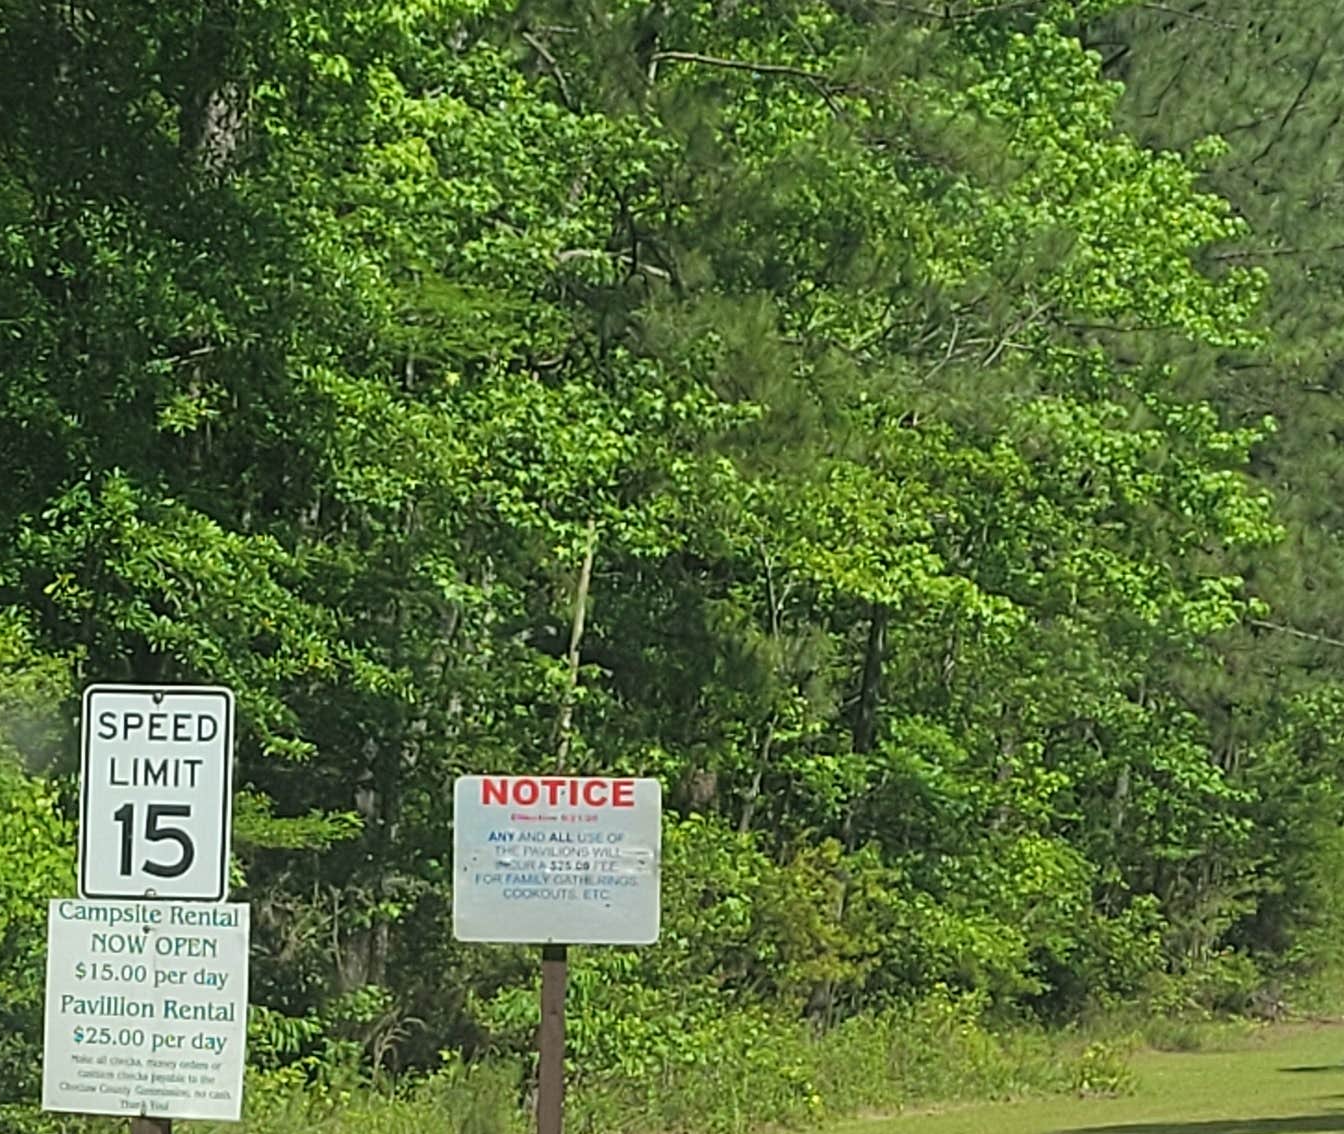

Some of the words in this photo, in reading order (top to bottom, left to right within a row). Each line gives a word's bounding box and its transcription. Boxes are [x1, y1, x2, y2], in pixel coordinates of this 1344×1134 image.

[97, 711, 218, 743] SPEED
[109, 757, 203, 788] LIMIT
[482, 778, 635, 808] NOTICE
[113, 802, 195, 879] 15
[488, 831, 514, 842] ANY
[518, 831, 546, 843] AND
[548, 831, 574, 843] ALL
[577, 832, 603, 844] USE
[606, 833, 624, 844] OF
[494, 846, 519, 857] THE
[523, 846, 590, 858] PAVILIONS
[592, 847, 622, 858] WILL
[475, 874, 503, 886] FOR
[505, 875, 549, 886] FAMILY
[58, 901, 162, 927] Campsite
[170, 905, 239, 928] Rental
[90, 932, 147, 954] NOW
[155, 936, 218, 958] OPEN
[75, 961, 147, 983] $15.00
[153, 969, 188, 989] per
[193, 969, 229, 990] day
[60, 994, 155, 1019] Pavillion
[163, 1000, 236, 1022] Rental
[72, 1025, 145, 1047] $25.00
[151, 1033, 187, 1053] per
[191, 1032, 228, 1055] day
